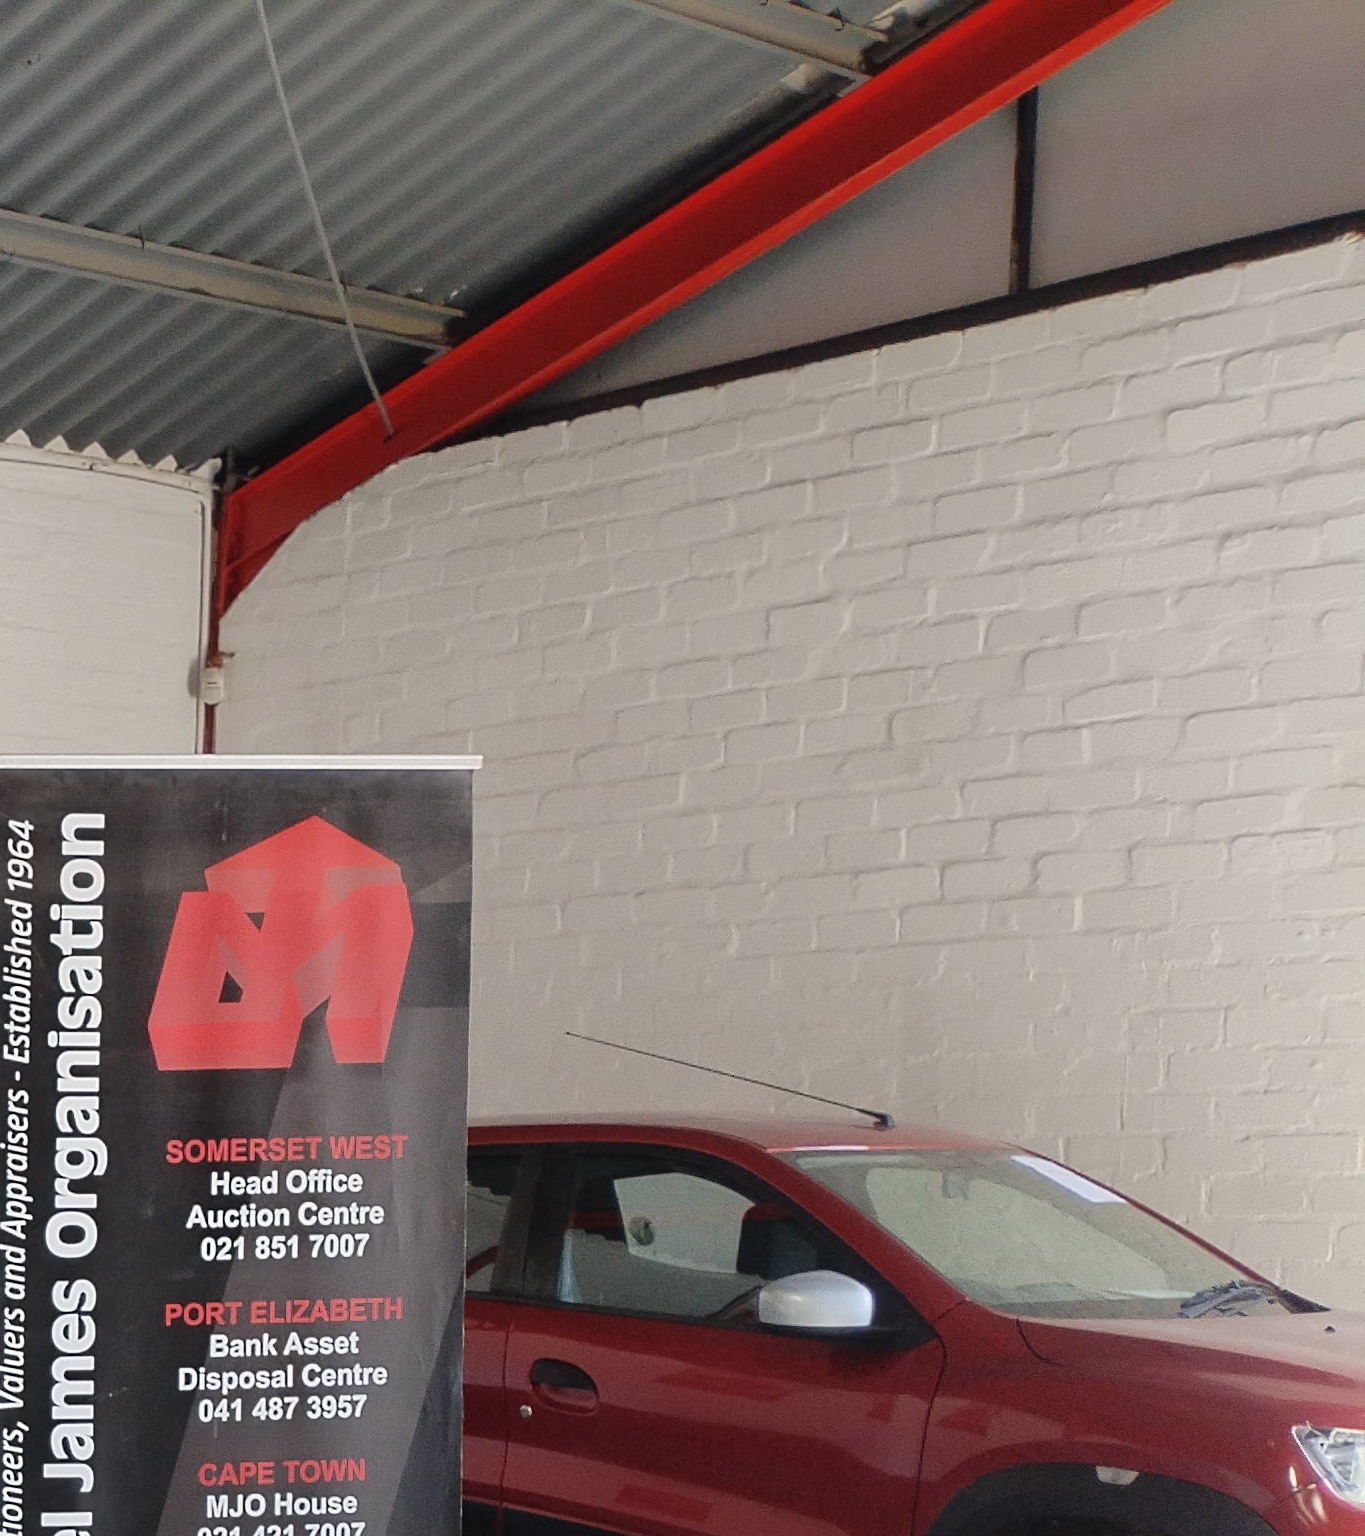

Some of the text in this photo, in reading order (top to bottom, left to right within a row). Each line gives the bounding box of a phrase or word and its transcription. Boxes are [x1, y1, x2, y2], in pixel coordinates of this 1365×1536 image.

[7, 819, 34, 891] 1964
[2, 898, 33, 1064] Established
[45, 813, 108, 1259] Organisation
[0, 1088, 34, 1240] Appraisers
[166, 1135, 408, 1164] SOMERSET WEST
[210, 1168, 364, 1196] Head Office
[185, 1201, 385, 1229] Auction Centre
[200, 1232, 370, 1262] 021 851 7007
[164, 1297, 402, 1327] PORT ELIZABETH
[209, 1330, 360, 1358] Bank Asset
[42, 1278, 97, 1493] James
[178, 1362, 388, 1395] Disposal Centre
[198, 1393, 368, 1423] 041 487 3957
[198, 1459, 366, 1487] CAPE TOWN
[206, 1492, 358, 1519] MJO House
